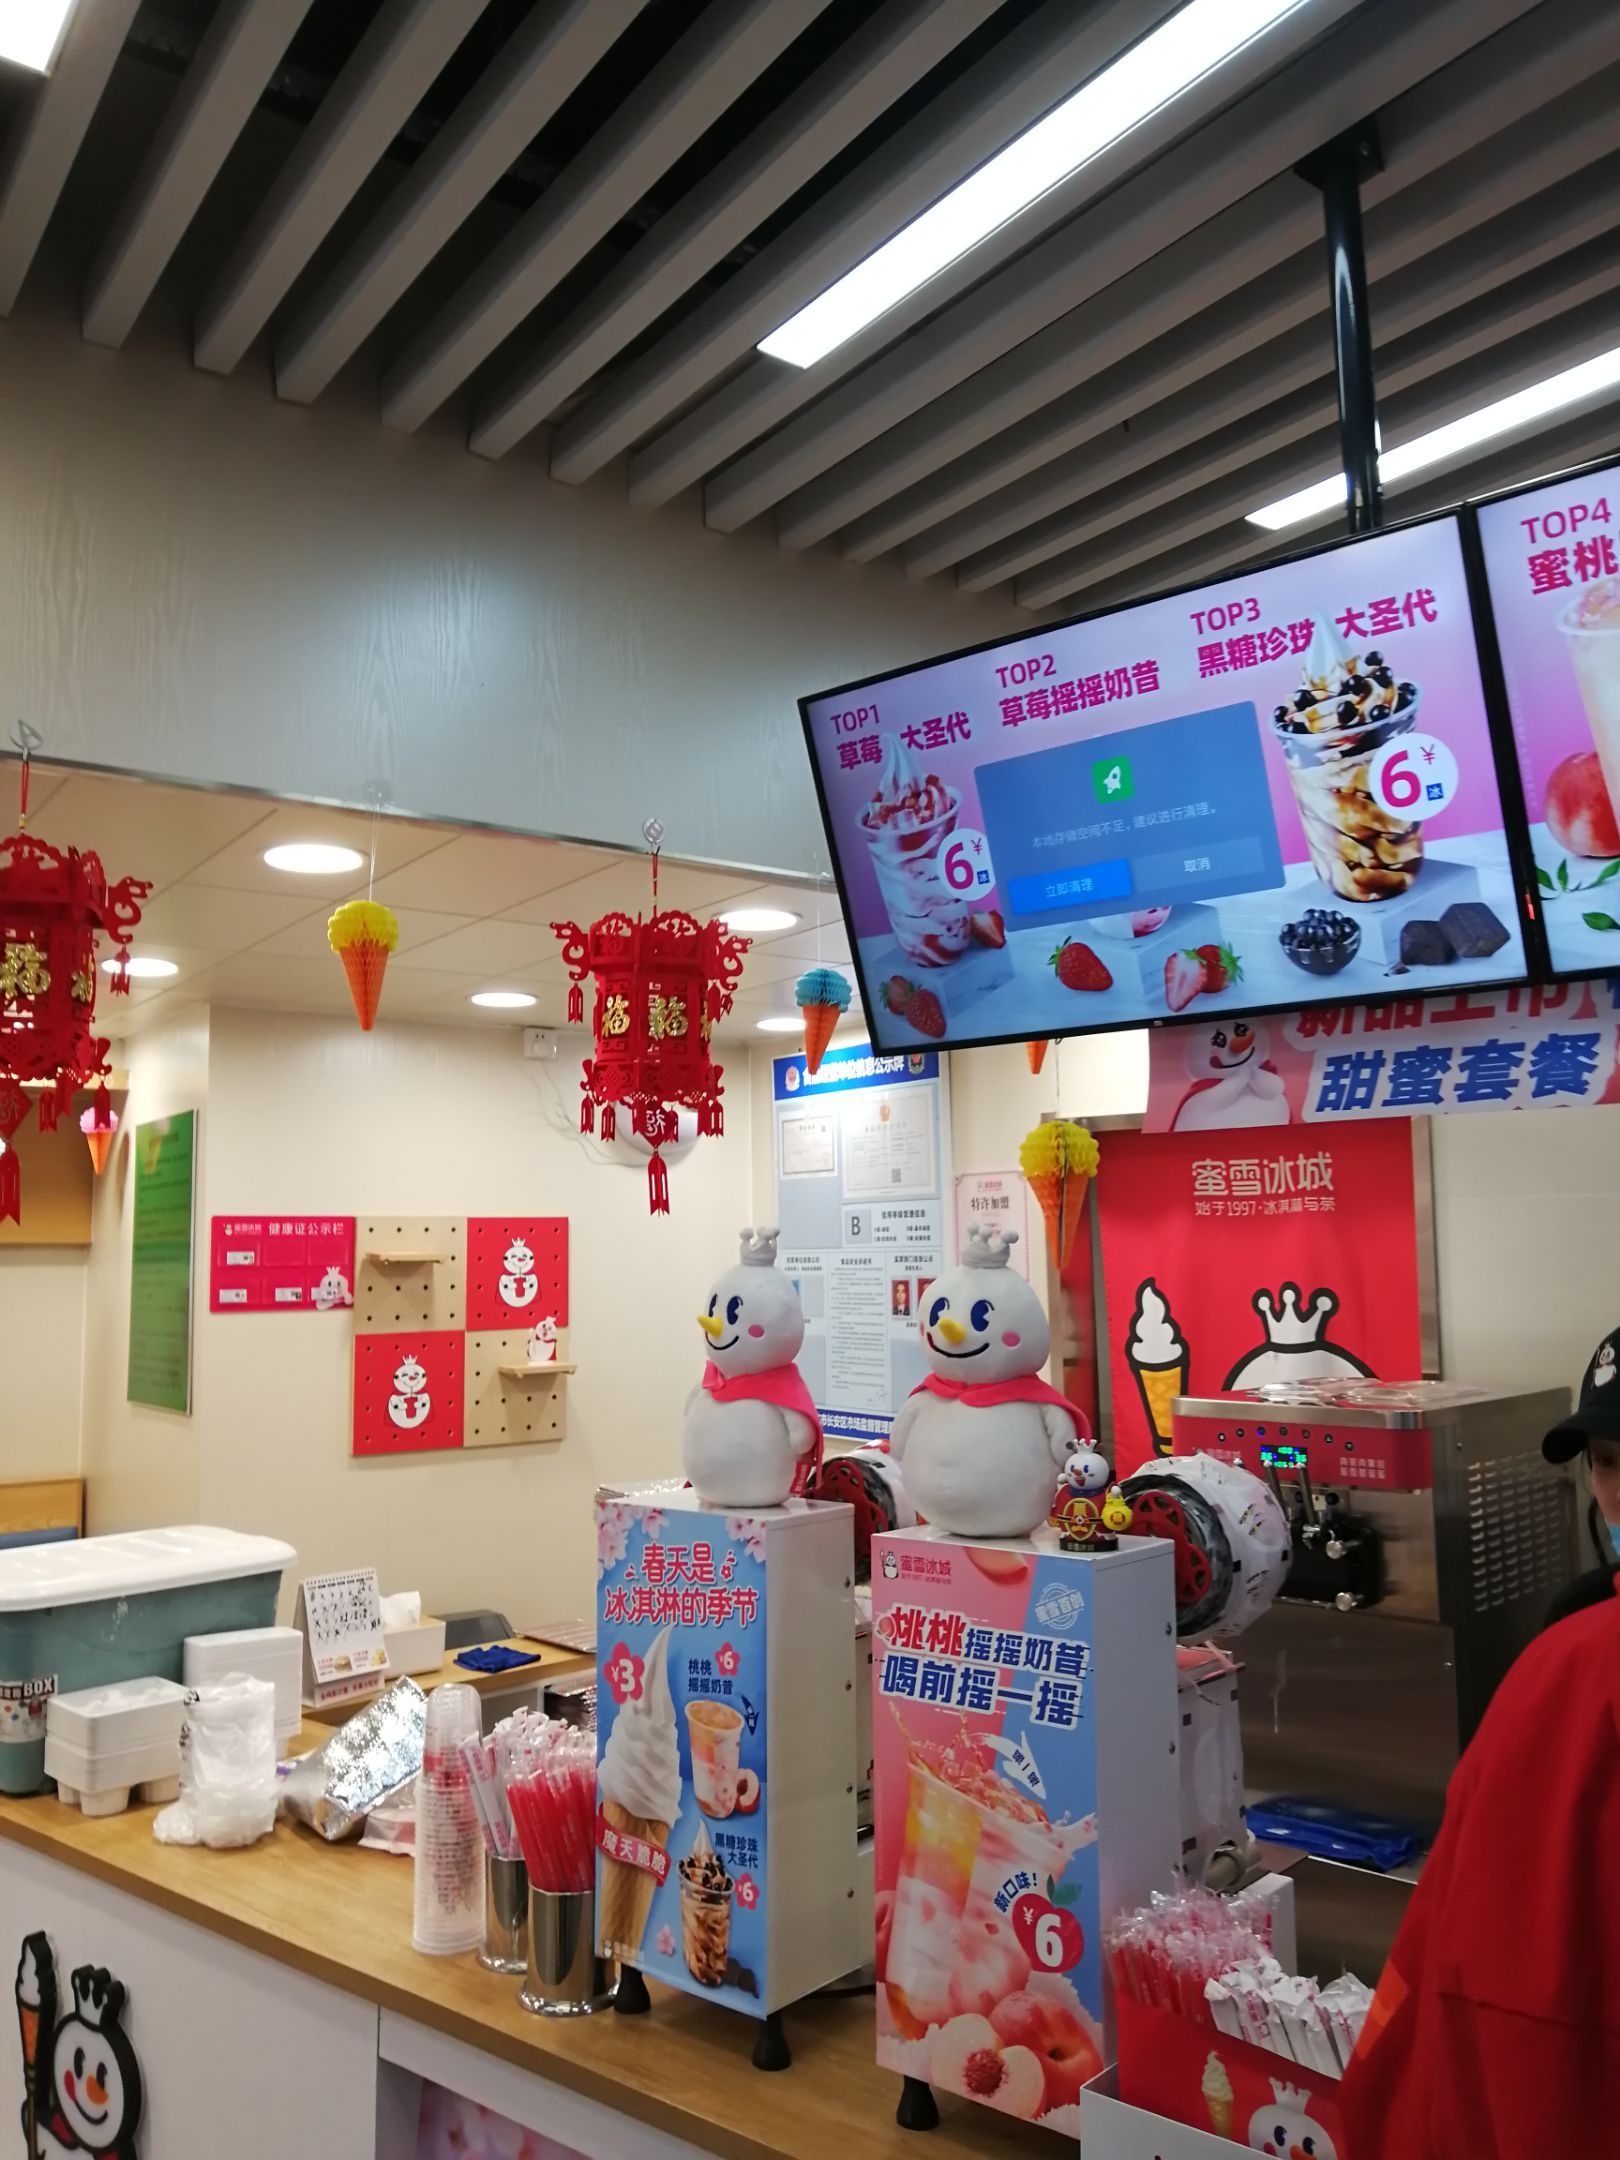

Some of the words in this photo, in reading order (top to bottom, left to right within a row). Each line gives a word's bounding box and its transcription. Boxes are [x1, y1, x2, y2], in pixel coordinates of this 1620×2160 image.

[1520, 497, 1612, 544] TOP4
[1190, 597, 1261, 635] TOP3
[1197, 618, 1315, 679] 黑糖珍珠
[1335, 588, 1438, 640] 大圣代
[995, 654, 1057, 688] TOP2
[998, 659, 1160, 727] 草莓摇摇奶昔
[830, 704, 880, 735] TOP1
[836, 735, 882, 770] 草莓
[900, 711, 972, 751] 大圣代
[1381, 749, 1421, 808] 6
[944, 841, 975, 890] 6
[1183, 857, 1212, 873] 取消
[1045, 877, 1095, 898] 立即清理
[1315, 1033, 1602, 1113] 甜蜜套餐
[1191, 1151, 1335, 1197] 蜜雪冰城
[970, 1195, 1010, 1211] 特许加盟
[268, 1221, 344, 1236] 健康证公示栏
[851, 1216, 861, 1236] B
[641, 1542, 716, 1585] 春天是
[603, 1585, 760, 1629] 冰淇淋的季节
[688, 1657, 712, 1676] 桃桃
[23, 1676, 54, 1697] BOX
[688, 1676, 734, 1696] 摇摇奶昔
[882, 1653, 1079, 1727] 喝前摇一摇
[727, 1852, 759, 1869] 大圣代
